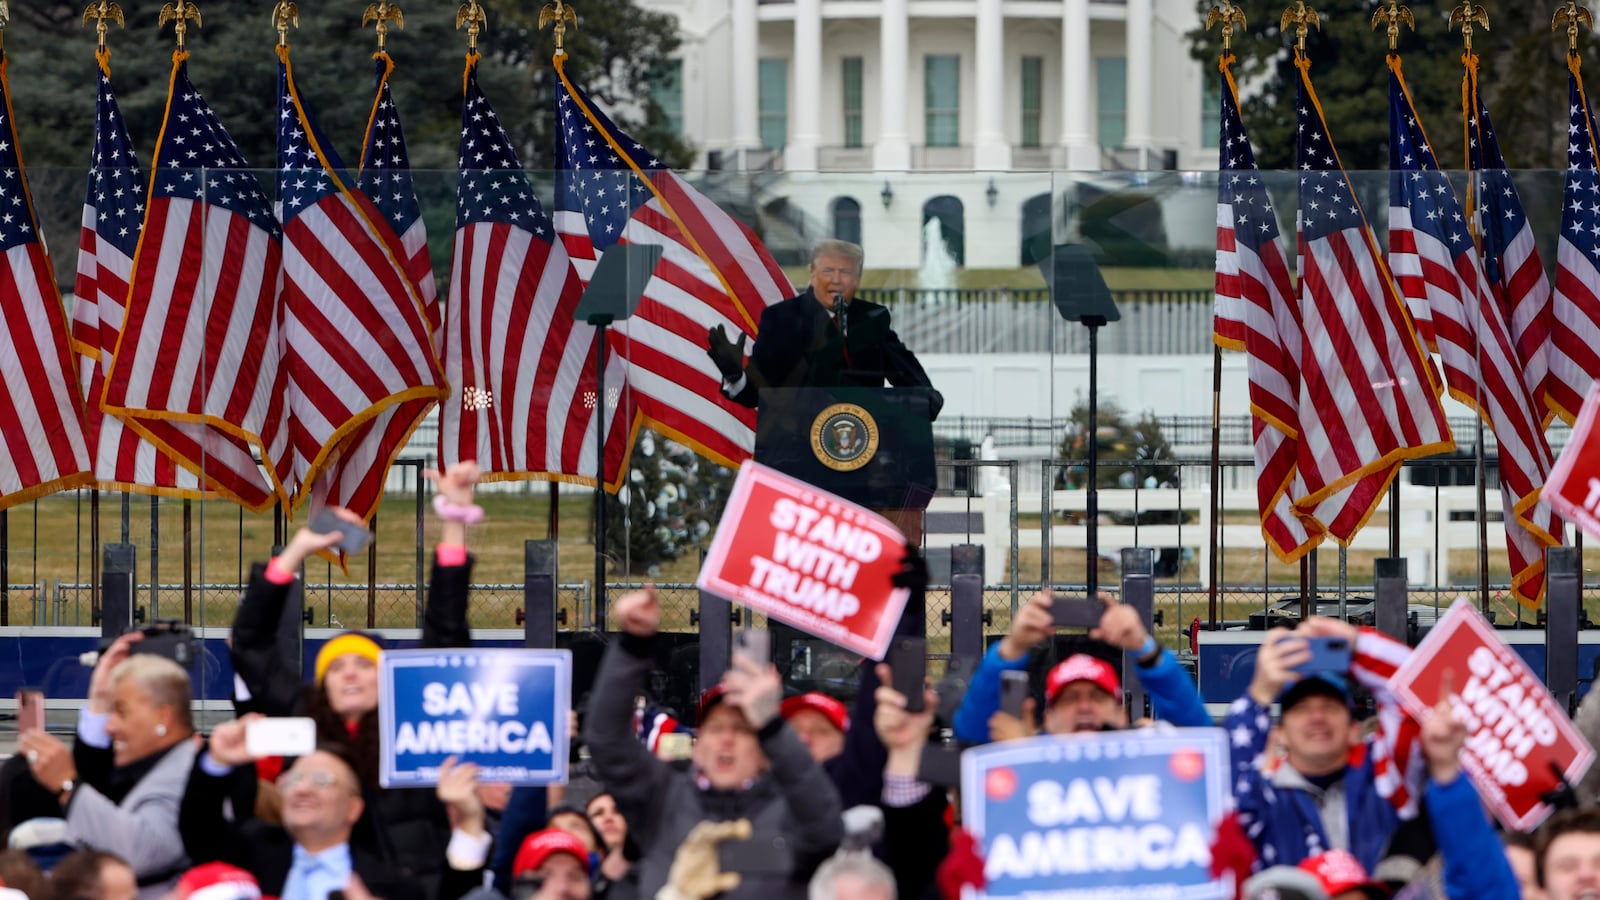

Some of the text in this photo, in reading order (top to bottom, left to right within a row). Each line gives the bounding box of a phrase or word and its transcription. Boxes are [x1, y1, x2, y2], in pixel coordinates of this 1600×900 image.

[770, 498, 882, 563] STAND
[750, 555, 860, 621] TRUMP
[773, 531, 860, 589] WITH
[422, 682, 519, 716] SAVE
[1462, 676, 1536, 758] WITH
[1467, 646, 1557, 746] STAND
[396, 720, 552, 754] AMERICA
[1027, 774, 1161, 826] SAVE
[984, 822, 1211, 879] AMERICA
